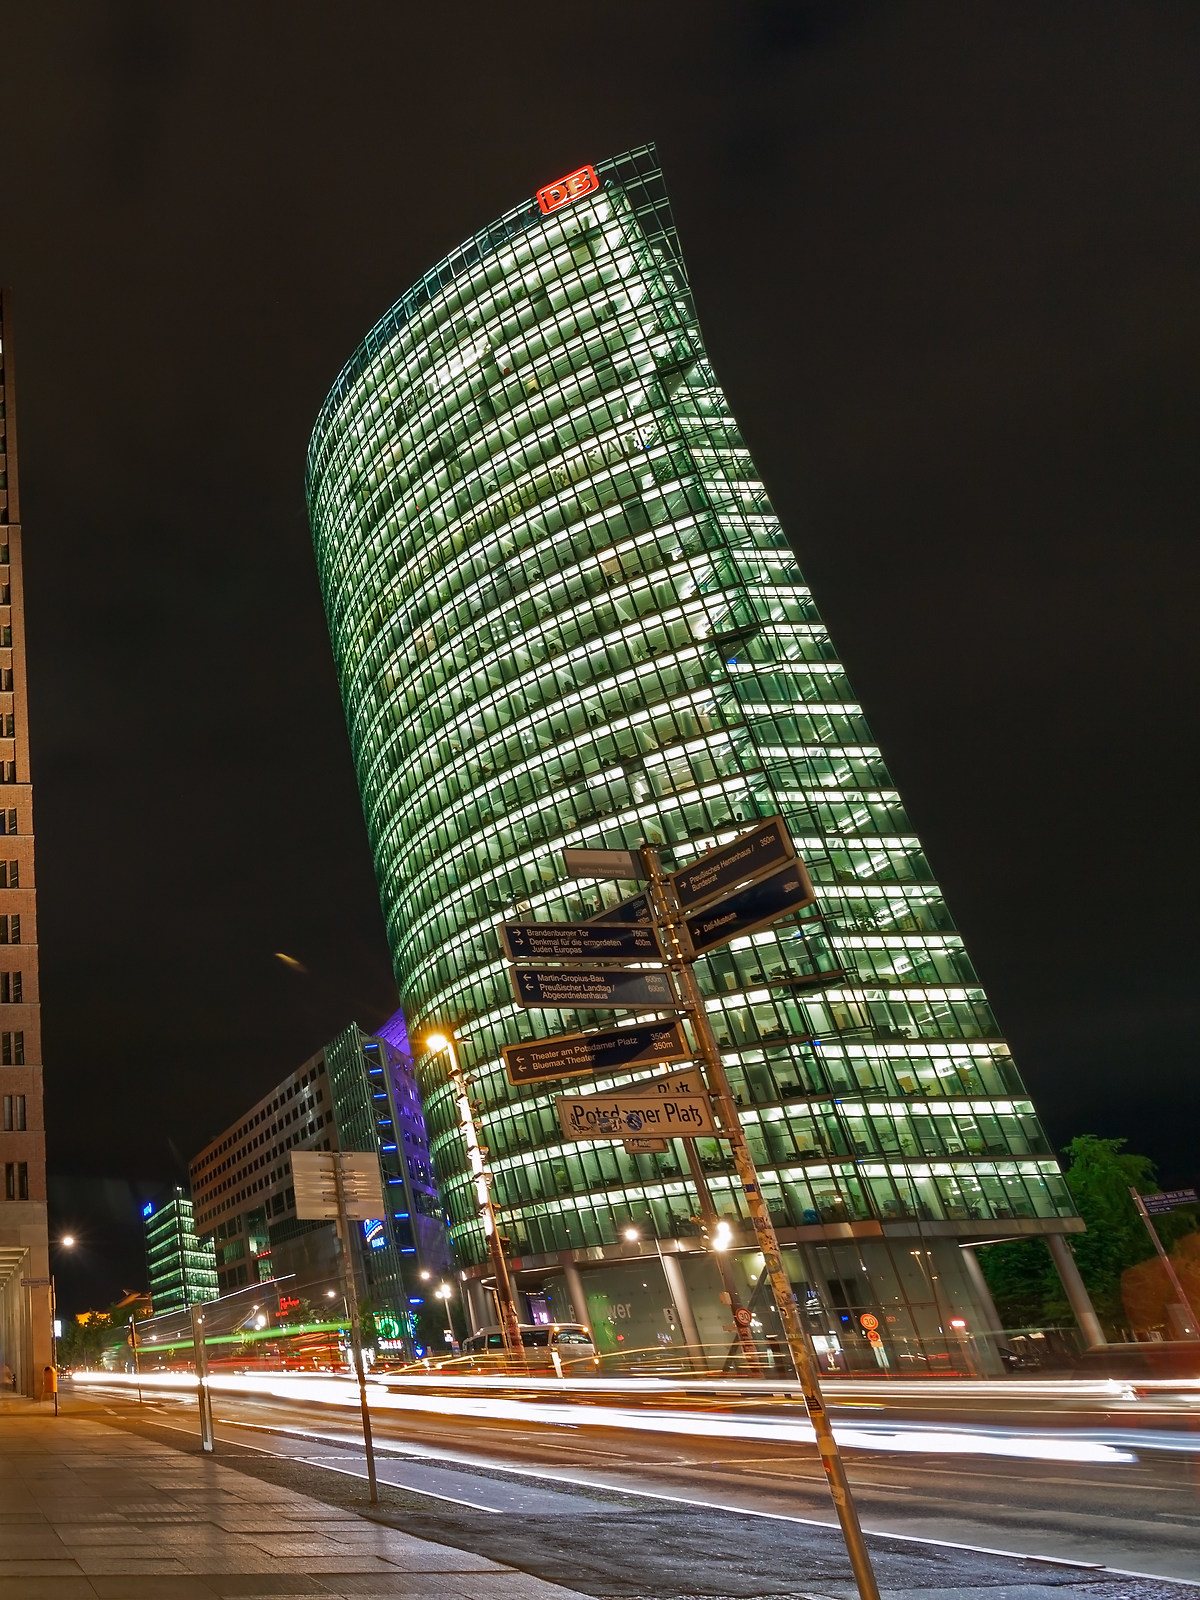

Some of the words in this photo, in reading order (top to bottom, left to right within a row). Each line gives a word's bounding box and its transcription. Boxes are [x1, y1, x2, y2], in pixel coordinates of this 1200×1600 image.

[541, 169, 593, 210] DB
[689, 862, 721, 884] Preußisches
[720, 847, 752, 869] Herrenhaus
[691, 874, 718, 892] Bundesrat
[526, 929, 577, 938] Brandenburger
[577, 929, 589, 937] Tor
[529, 938, 560, 946] Denkmal
[560, 938, 571, 946] für
[571, 938, 582, 946] die
[634, 939, 652, 947] 400m
[554, 946, 583, 955] Europas
[537, 974, 605, 984] Martin-Gropius-Bau
[539, 984, 581, 992] Preußischer
[582, 984, 612, 993] Landtag
[542, 992, 608, 1001] Abgeordnetenhaus
[650, 1031, 671, 1041] 350m
[530, 1049, 560, 1062] Theater
[561, 1048, 573, 1057] am
[574, 1041, 616, 1054] Potsdamer
[617, 1036, 639, 1047] Platz
[653, 1041, 674, 1051] 350m
[532, 1059, 566, 1071] Bluemax
[567, 1053, 596, 1065] Theater
[573, 1103, 660, 1125] Potsdmer
[663, 1102, 703, 1126] Platz
[739, 1312, 749, 1321] 30
[864, 1317, 875, 1325] 30
